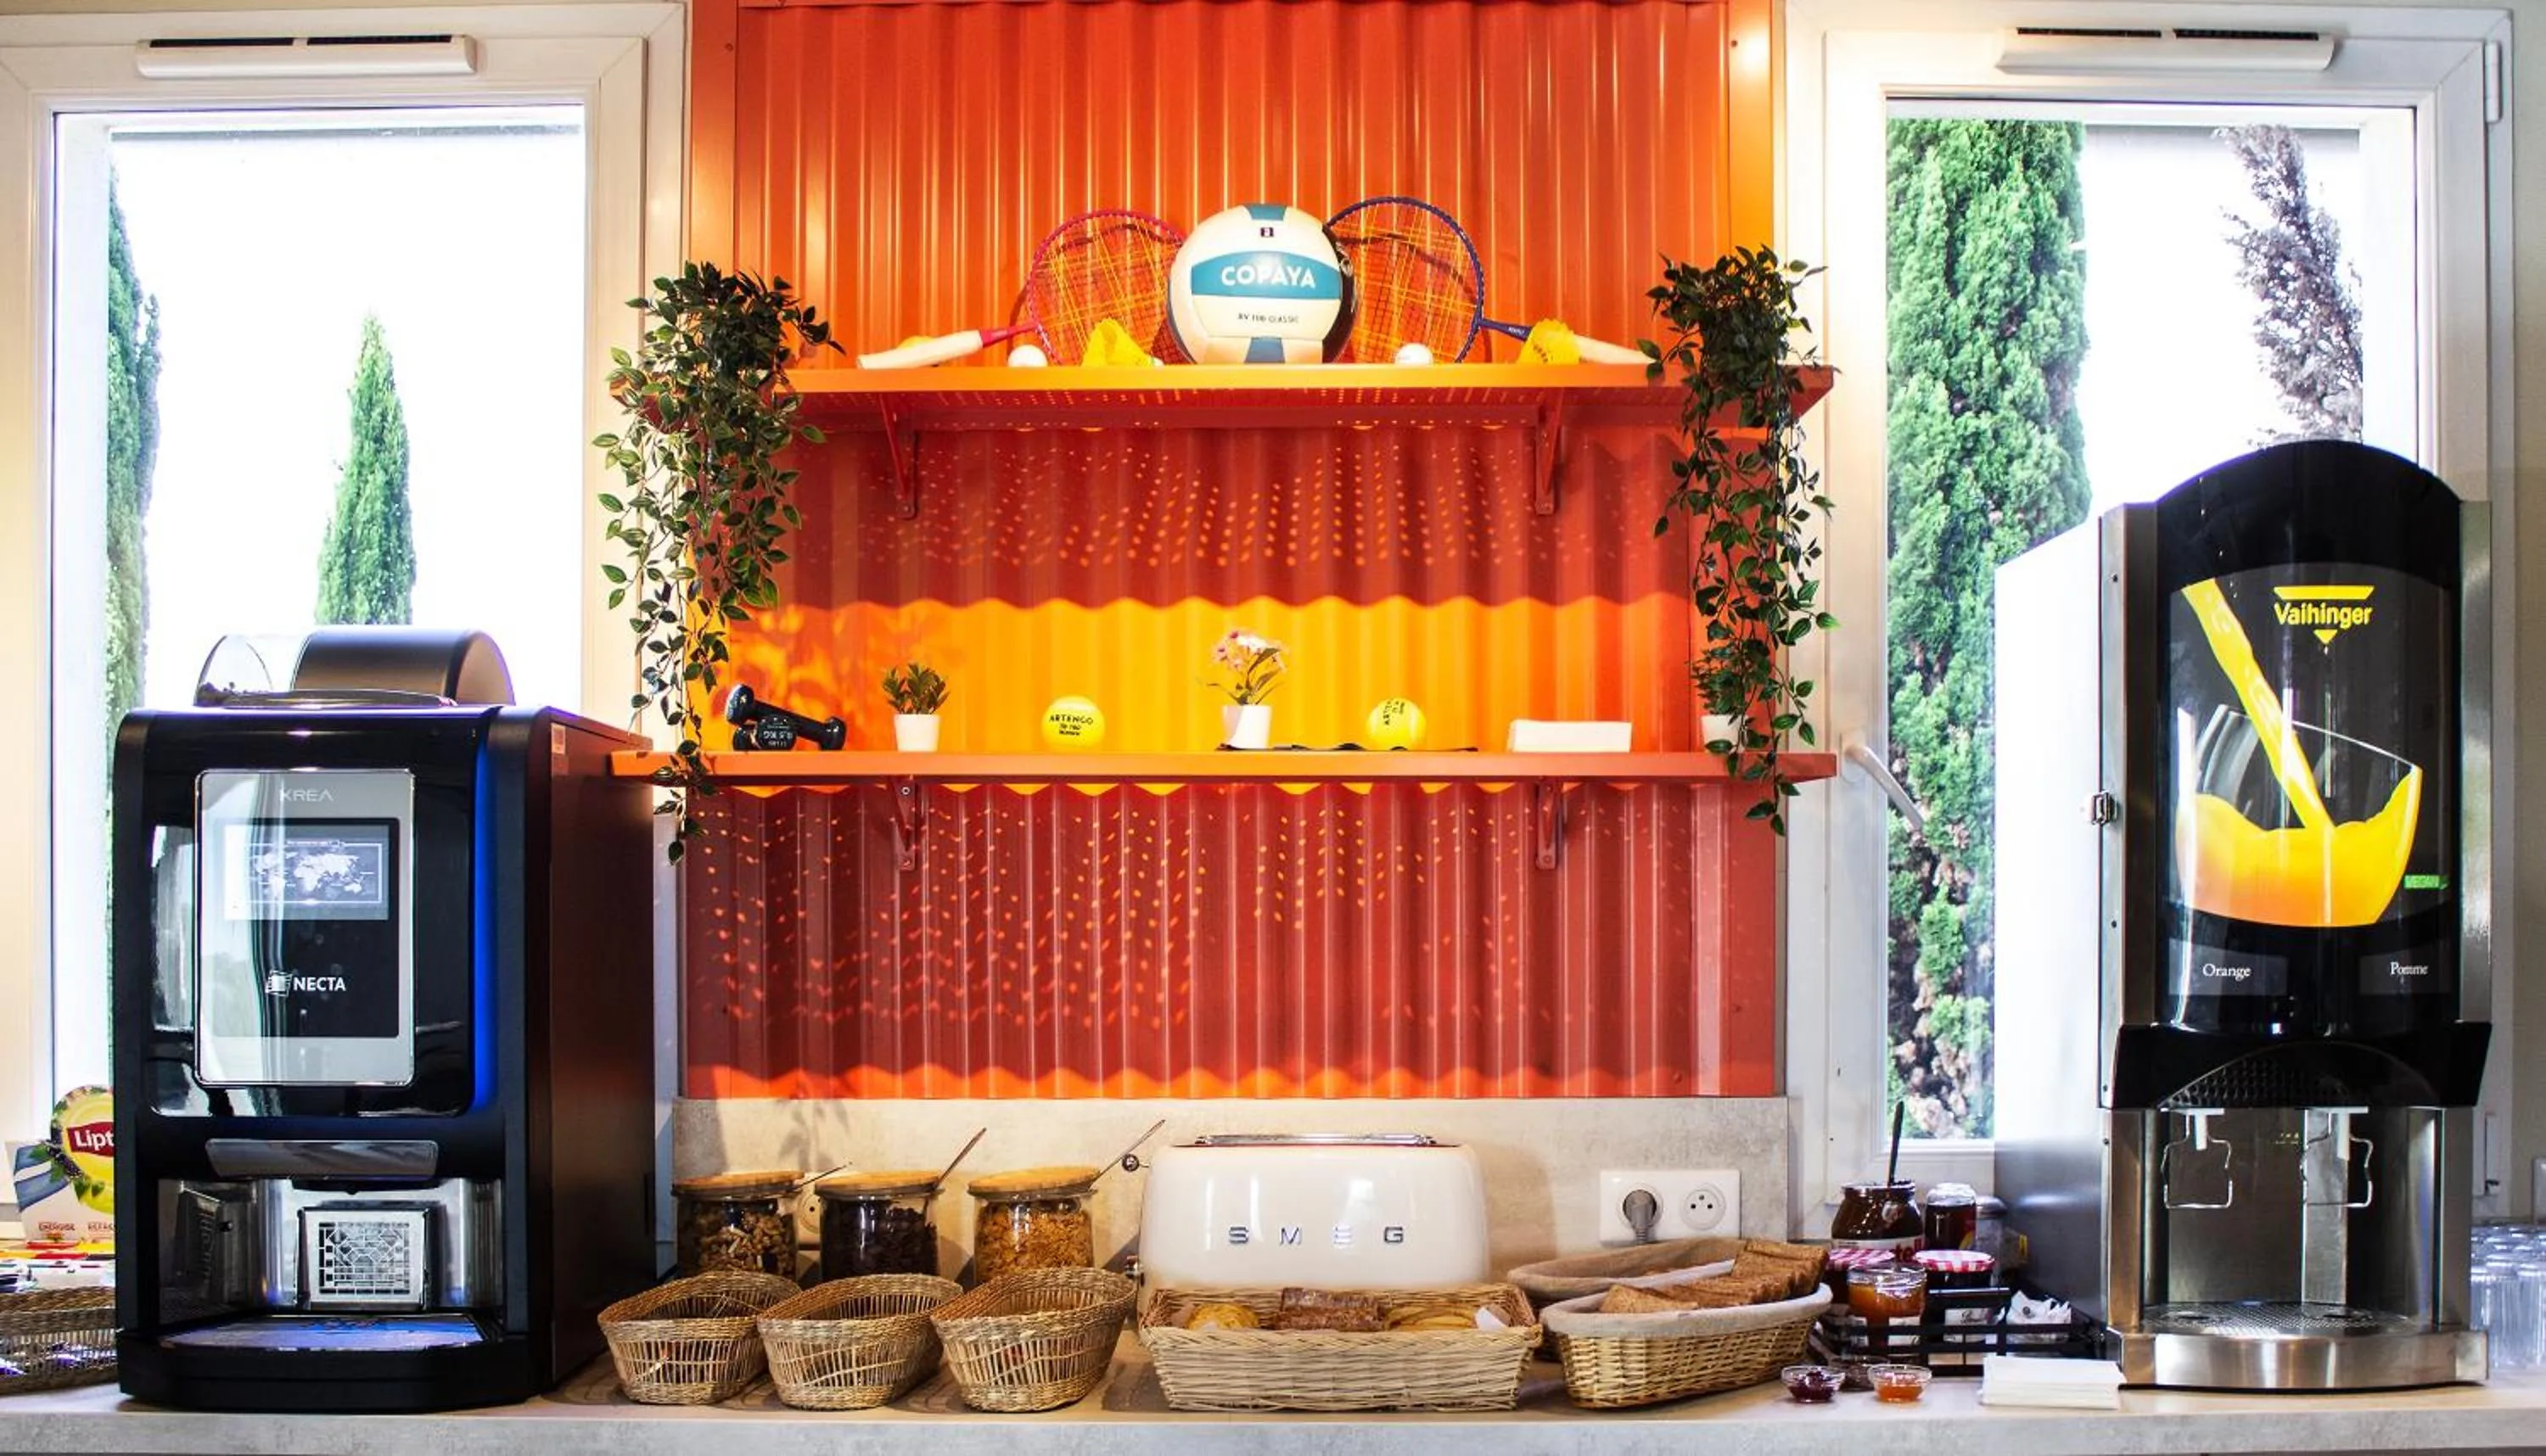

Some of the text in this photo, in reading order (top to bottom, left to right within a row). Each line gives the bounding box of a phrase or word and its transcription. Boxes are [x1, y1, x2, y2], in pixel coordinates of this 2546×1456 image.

[1221, 264, 1316, 288] COPAYA
[2274, 602, 2374, 629] Vaihinger
[1049, 714, 1093, 726] ARTENGO
[279, 787, 334, 802] KREA
[2202, 963, 2252, 978] Orange
[2390, 961, 2429, 976] Pomme
[293, 977, 346, 992] NECTA
